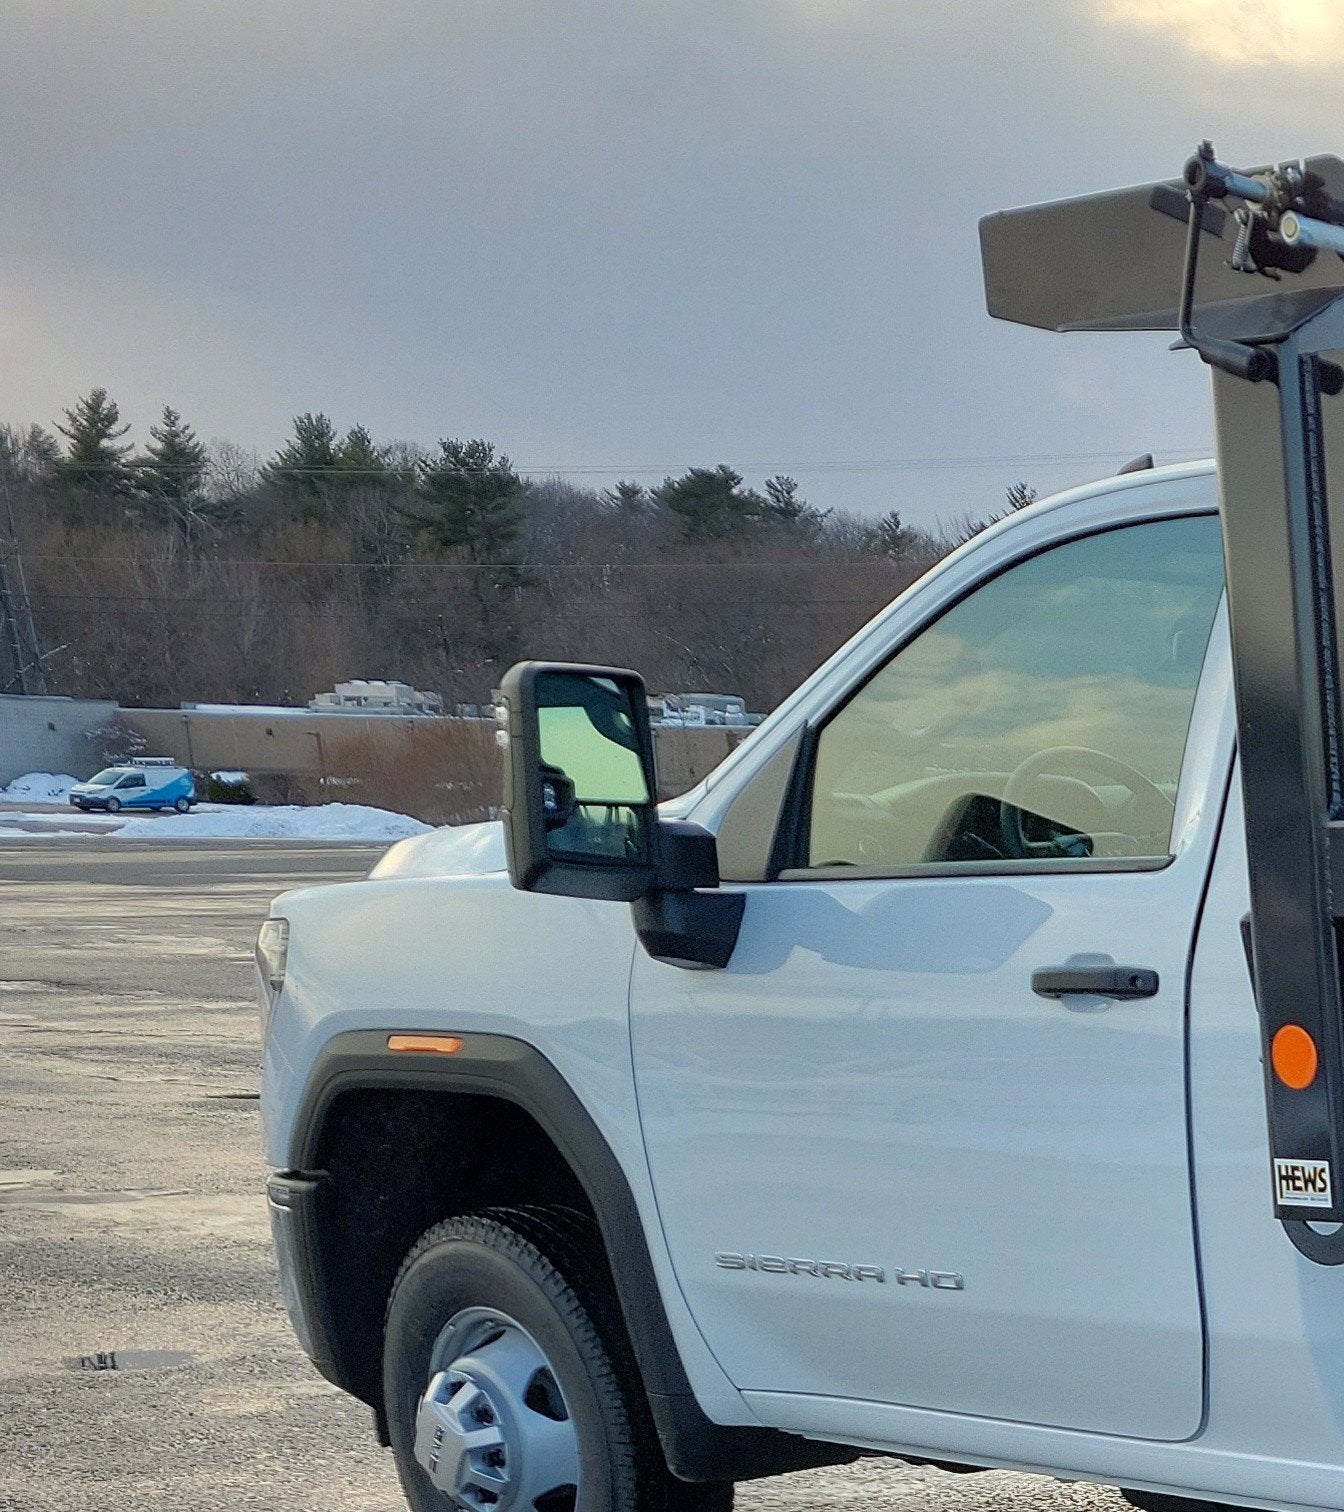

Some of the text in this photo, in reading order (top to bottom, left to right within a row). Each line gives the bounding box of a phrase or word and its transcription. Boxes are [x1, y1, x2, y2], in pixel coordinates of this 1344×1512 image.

[1277, 1164, 1328, 1199] HEWS
[714, 1251, 965, 1290] SIERRA HD
